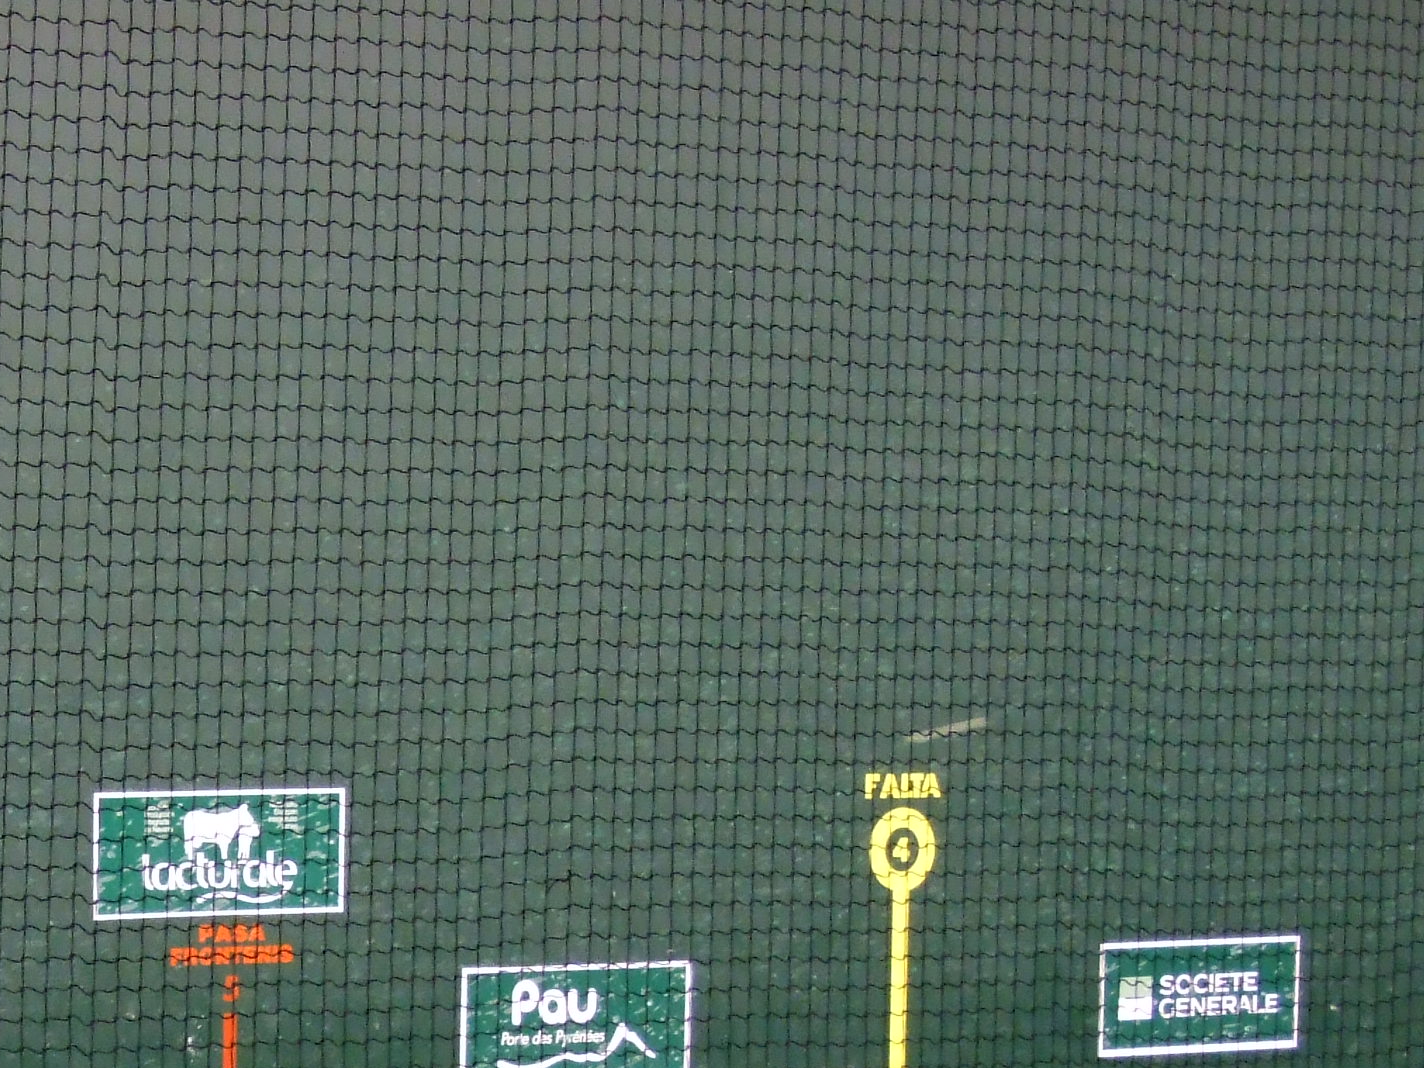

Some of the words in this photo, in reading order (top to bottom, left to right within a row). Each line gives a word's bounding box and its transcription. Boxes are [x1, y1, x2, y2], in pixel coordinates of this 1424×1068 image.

[864, 772, 941, 800] FALTA
[892, 836, 911, 863] 4
[198, 923, 267, 943] PASA
[1159, 971, 1259, 996] SOCIETE
[511, 979, 598, 1026] Pau
[1158, 993, 1281, 1019] GENERALE
[500, 1031, 530, 1046] Porte
[531, 1030, 553, 1045] des
